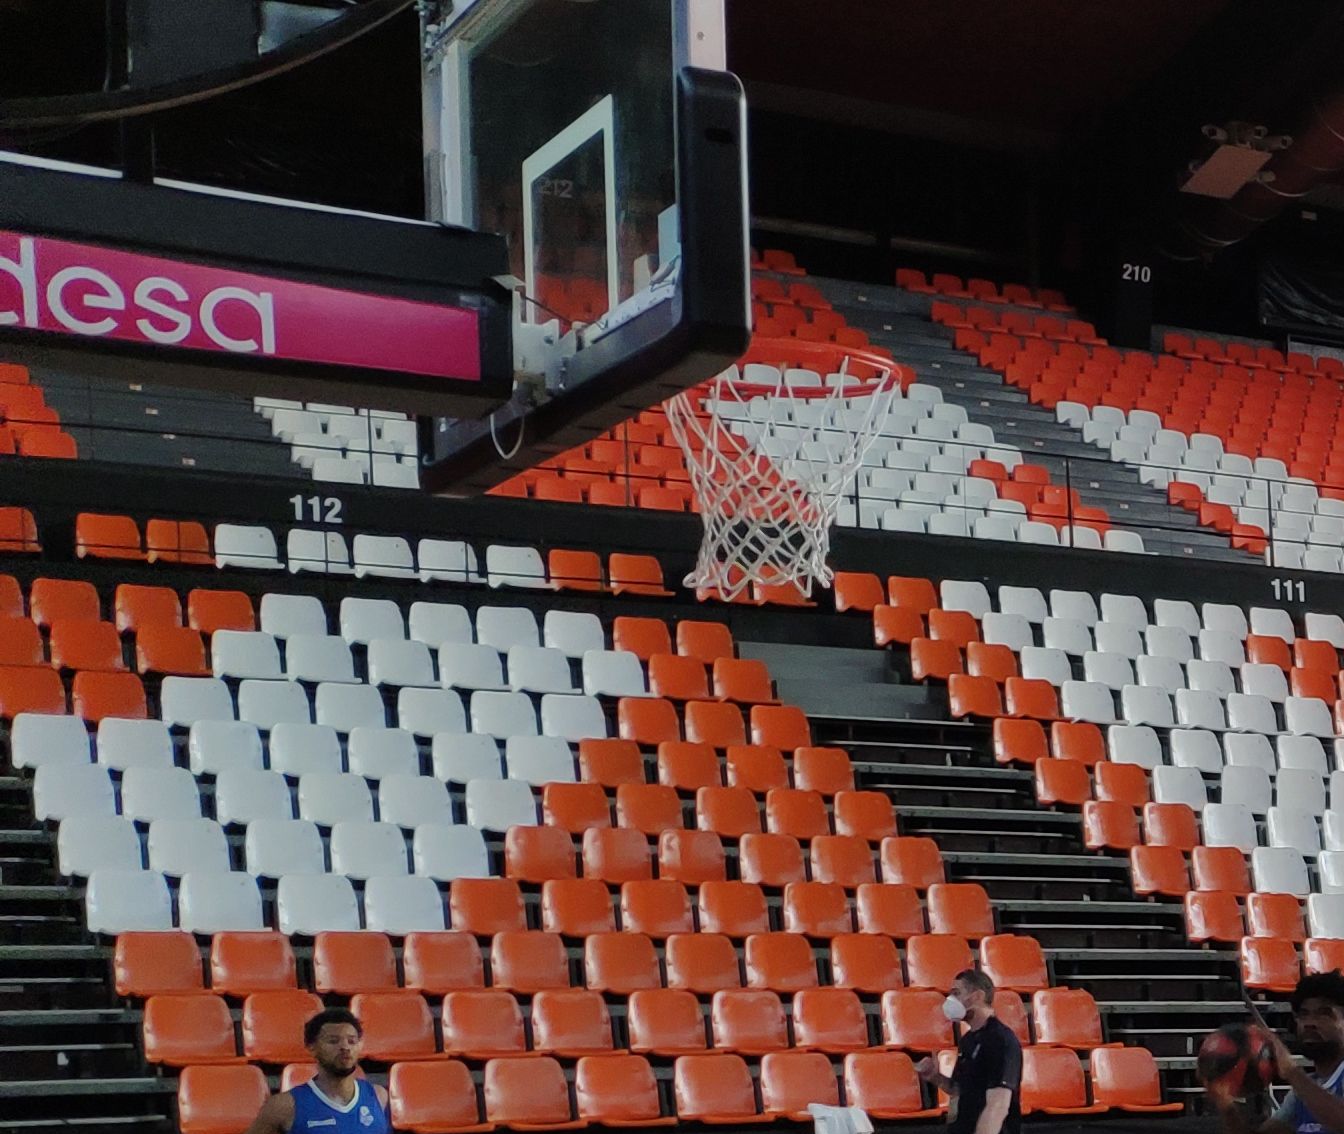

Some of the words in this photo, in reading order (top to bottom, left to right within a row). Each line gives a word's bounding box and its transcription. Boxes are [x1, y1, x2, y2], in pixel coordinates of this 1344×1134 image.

[1122, 263, 1151, 283] 210
[289, 494, 343, 524] 112
[1270, 578, 1305, 603] 111
